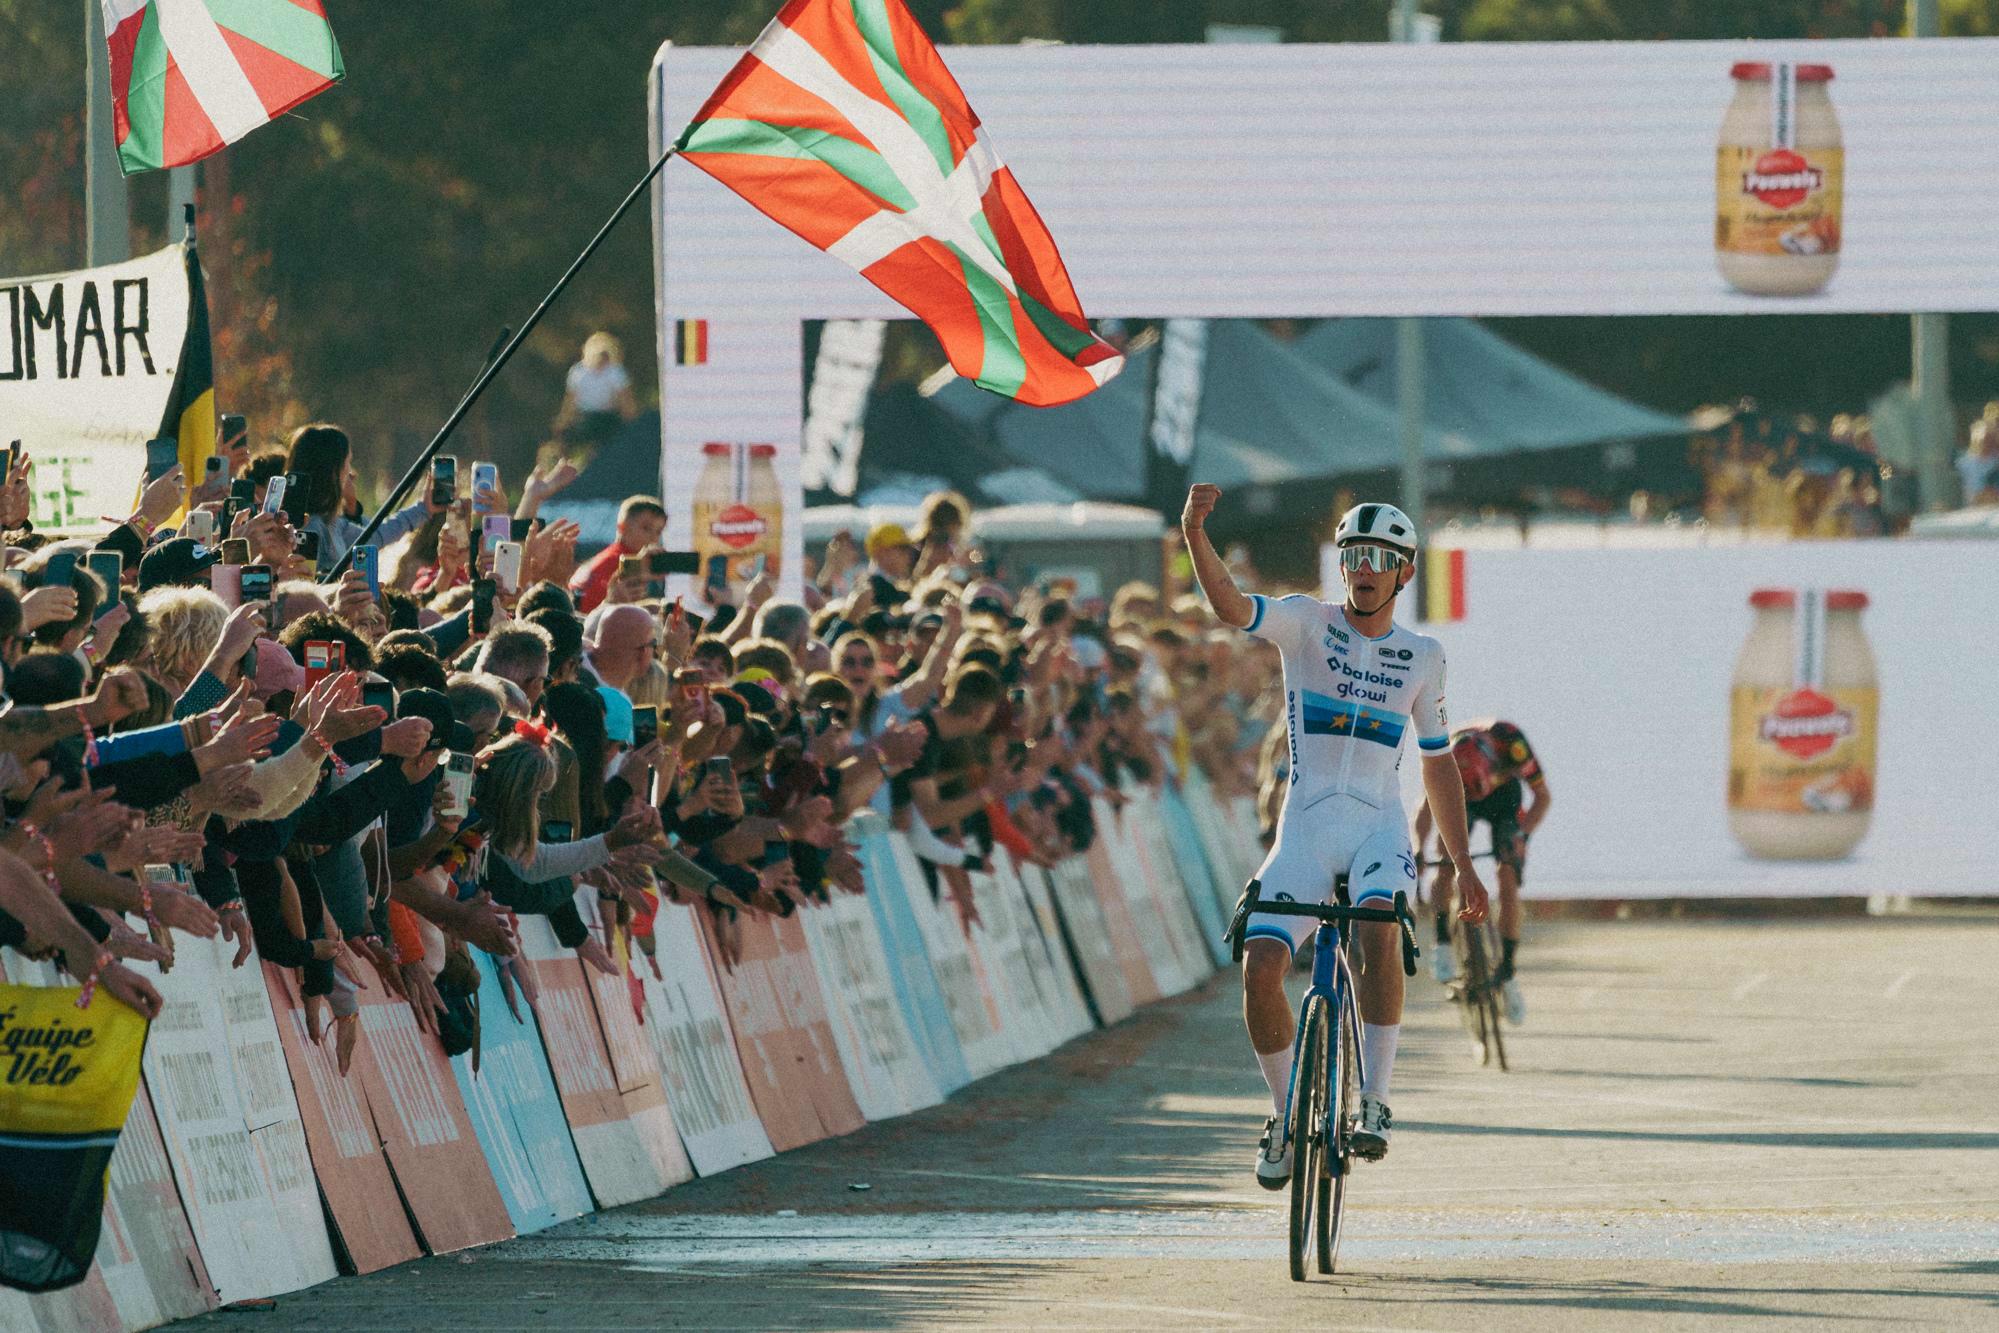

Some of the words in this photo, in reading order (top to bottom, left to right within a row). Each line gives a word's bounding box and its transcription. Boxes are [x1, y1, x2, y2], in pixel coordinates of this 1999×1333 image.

[1342, 662, 1404, 689] baloise
[1336, 681, 1387, 703] glowi
[1288, 690, 1298, 765] baloise
[7, 1052, 84, 1087] Vélo
